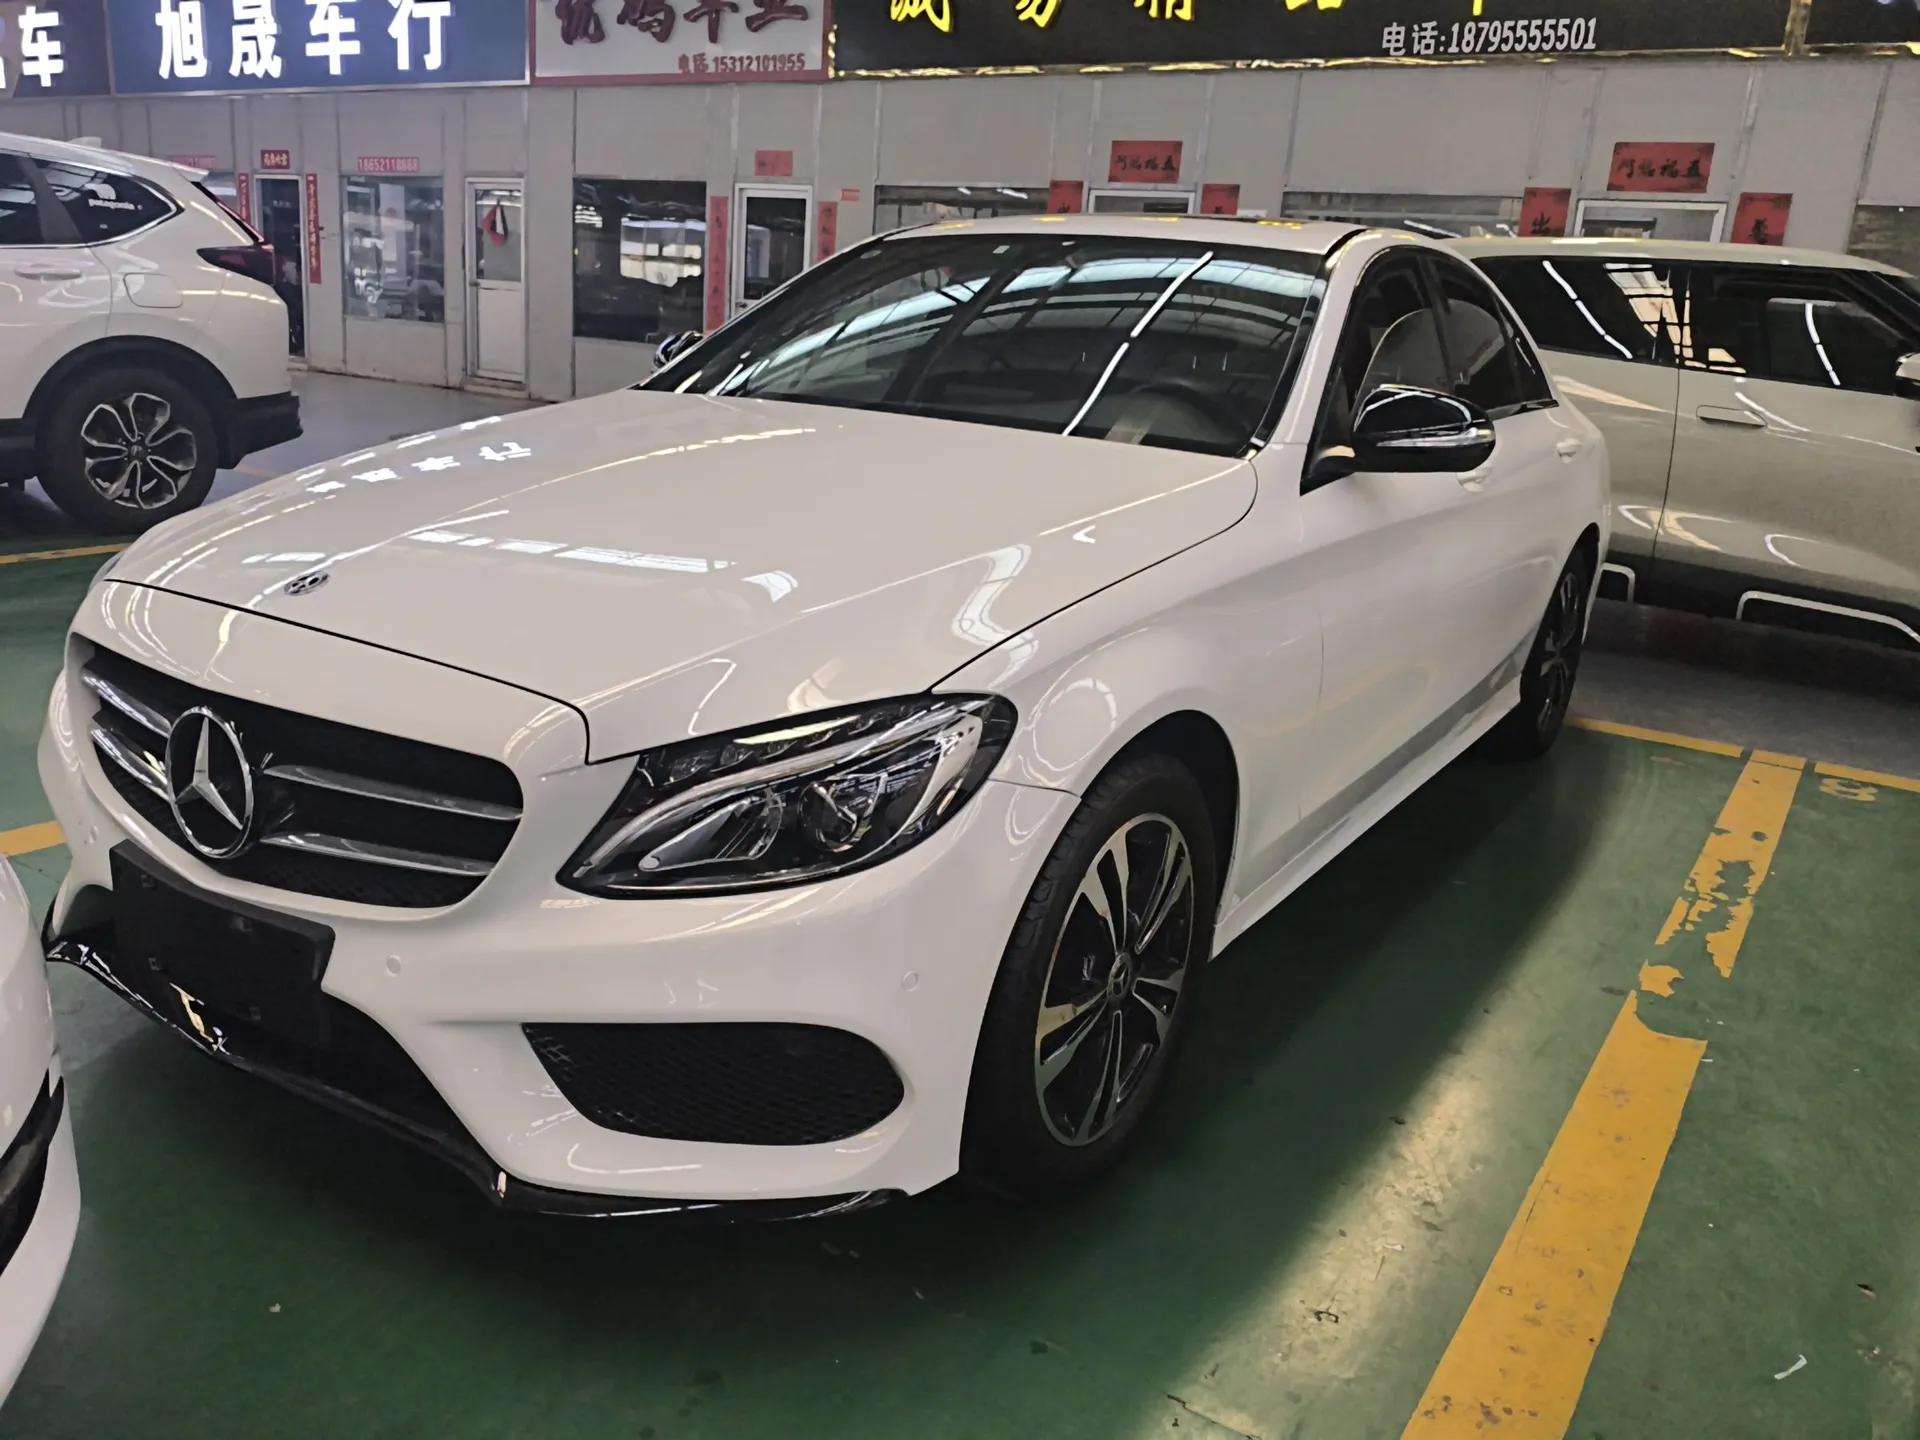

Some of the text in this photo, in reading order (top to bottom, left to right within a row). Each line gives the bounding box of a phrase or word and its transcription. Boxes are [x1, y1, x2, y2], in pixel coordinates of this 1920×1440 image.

[0, 6, 64, 89] 车
[155, 0, 452, 79] 旭晟车行
[1381, 17, 1597, 56] 电话:18795555501
